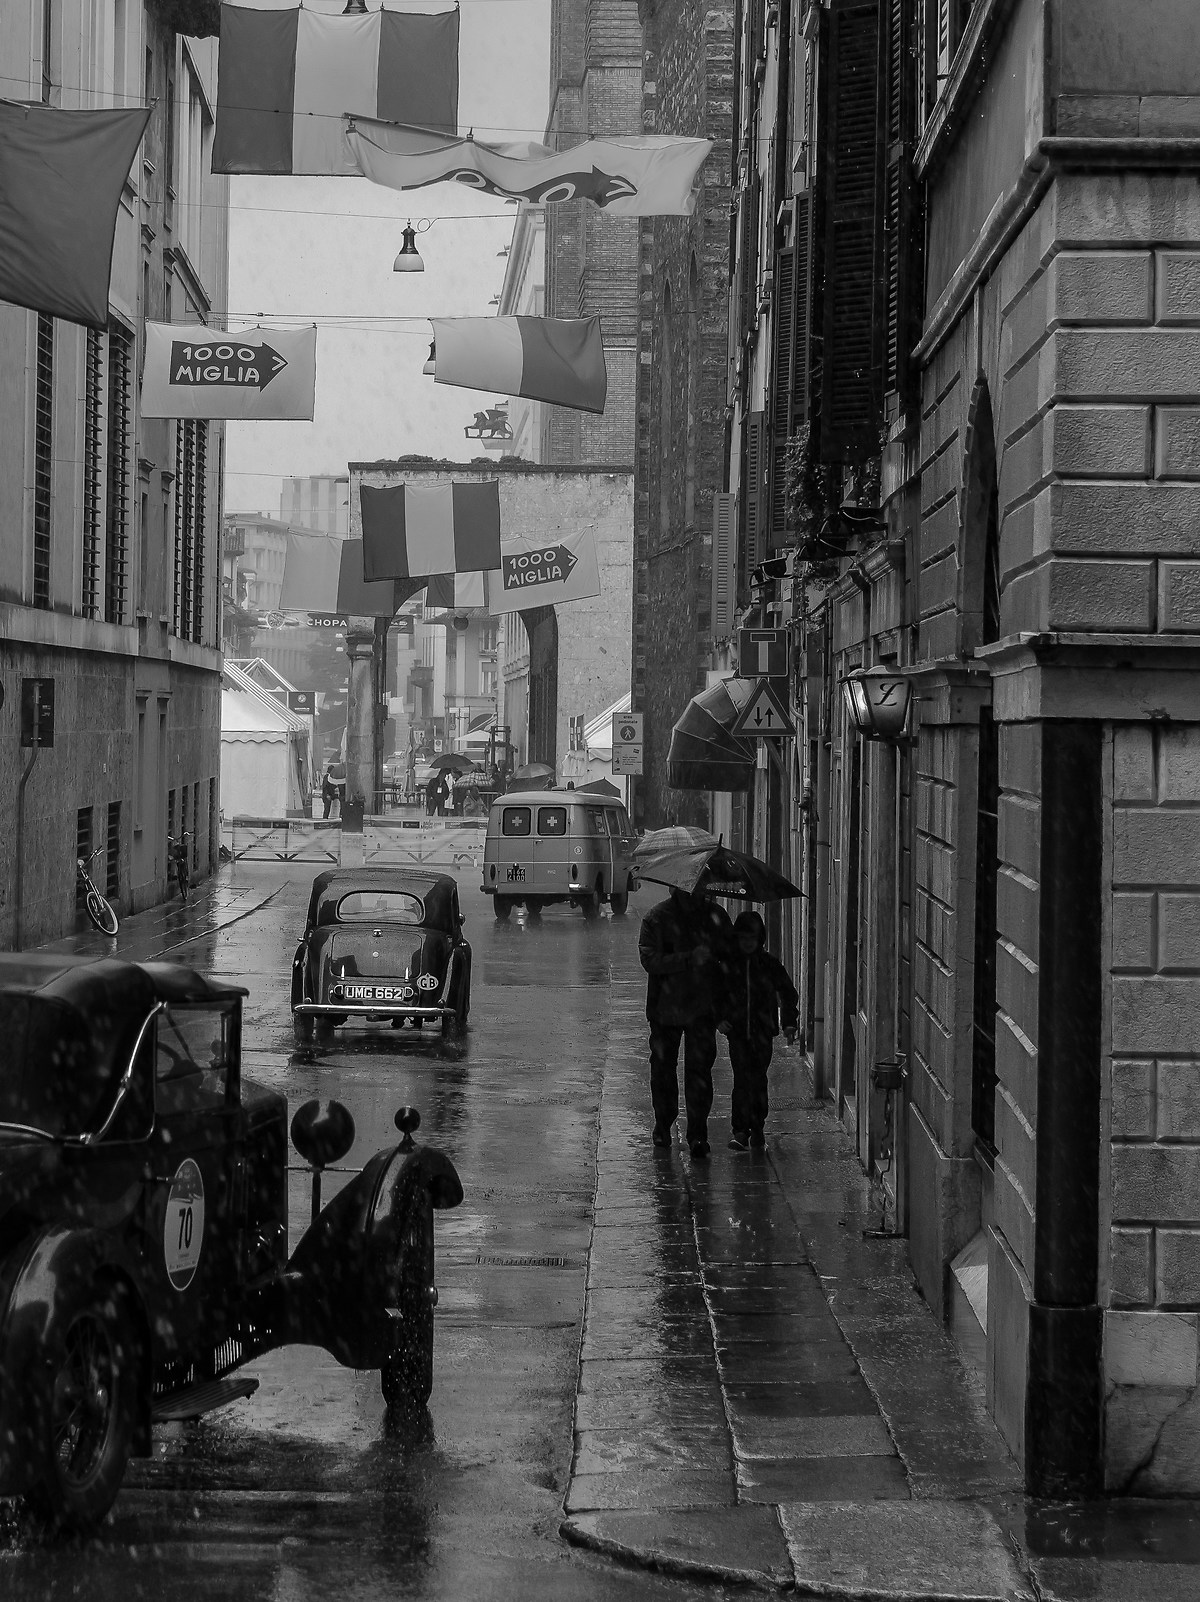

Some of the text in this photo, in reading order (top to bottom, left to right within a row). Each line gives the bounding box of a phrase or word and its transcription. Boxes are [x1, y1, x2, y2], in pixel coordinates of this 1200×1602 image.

[182, 343, 256, 363] 1000
[177, 364, 260, 385] MIGLIA
[509, 550, 556, 570] 1000
[506, 566, 562, 586] MIGLIA
[345, 986, 402, 999] UMG 662
[420, 978, 436, 988] GB
[178, 1206, 193, 1250] 70
